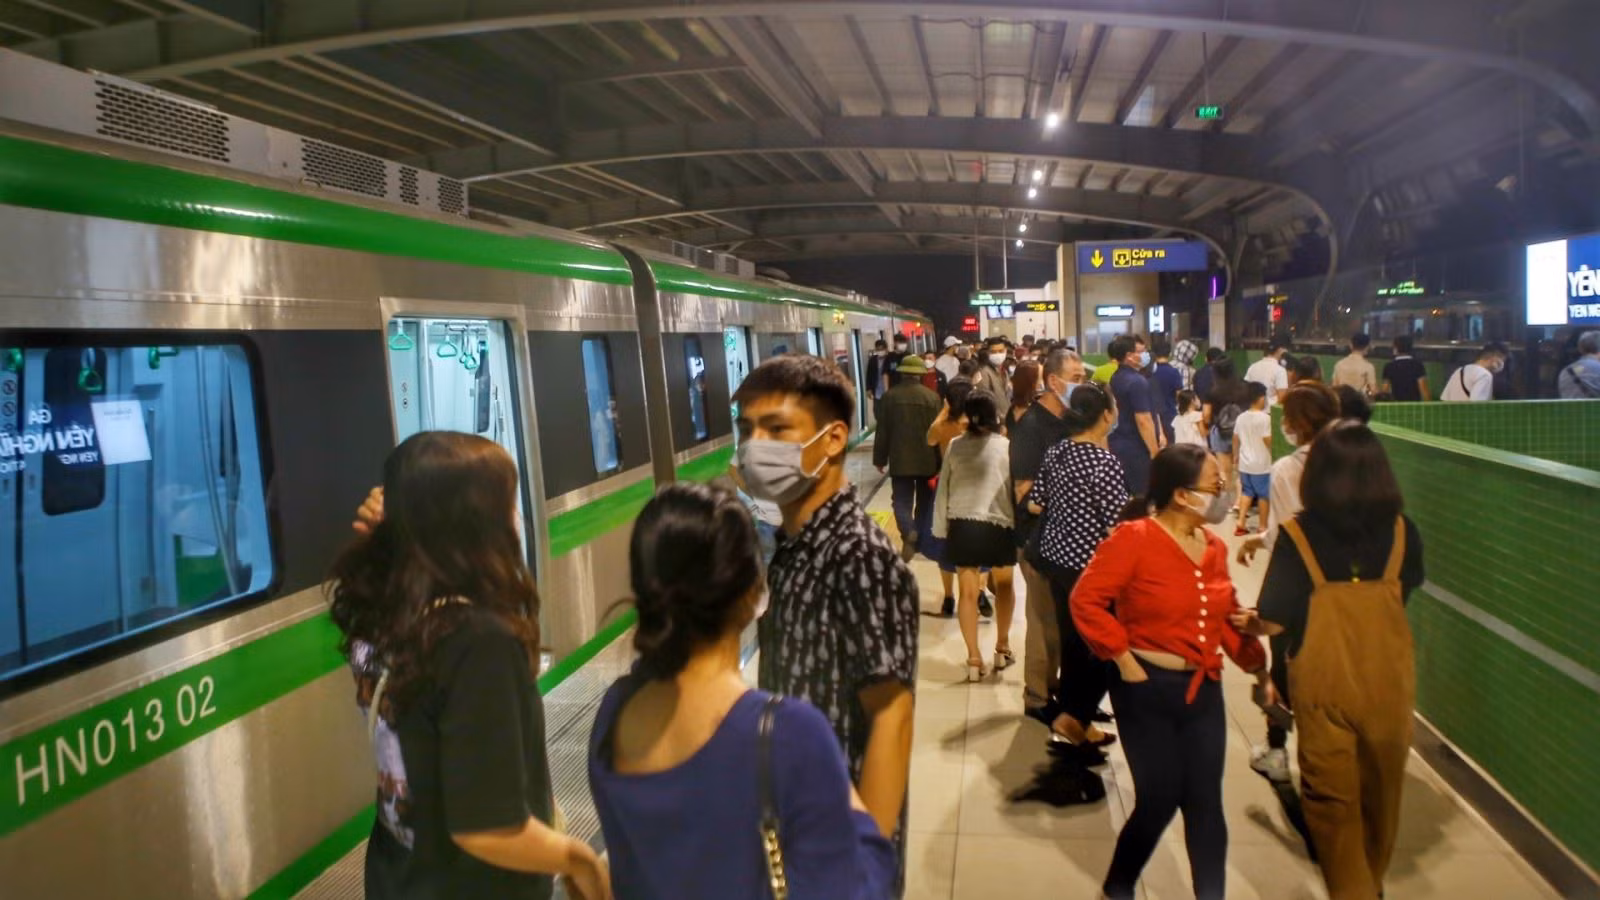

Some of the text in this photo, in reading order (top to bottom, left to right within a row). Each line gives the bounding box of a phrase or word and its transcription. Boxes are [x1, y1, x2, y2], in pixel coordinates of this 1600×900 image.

[1154, 250, 1165, 258] ra
[15, 675, 217, 806] HN013 02
